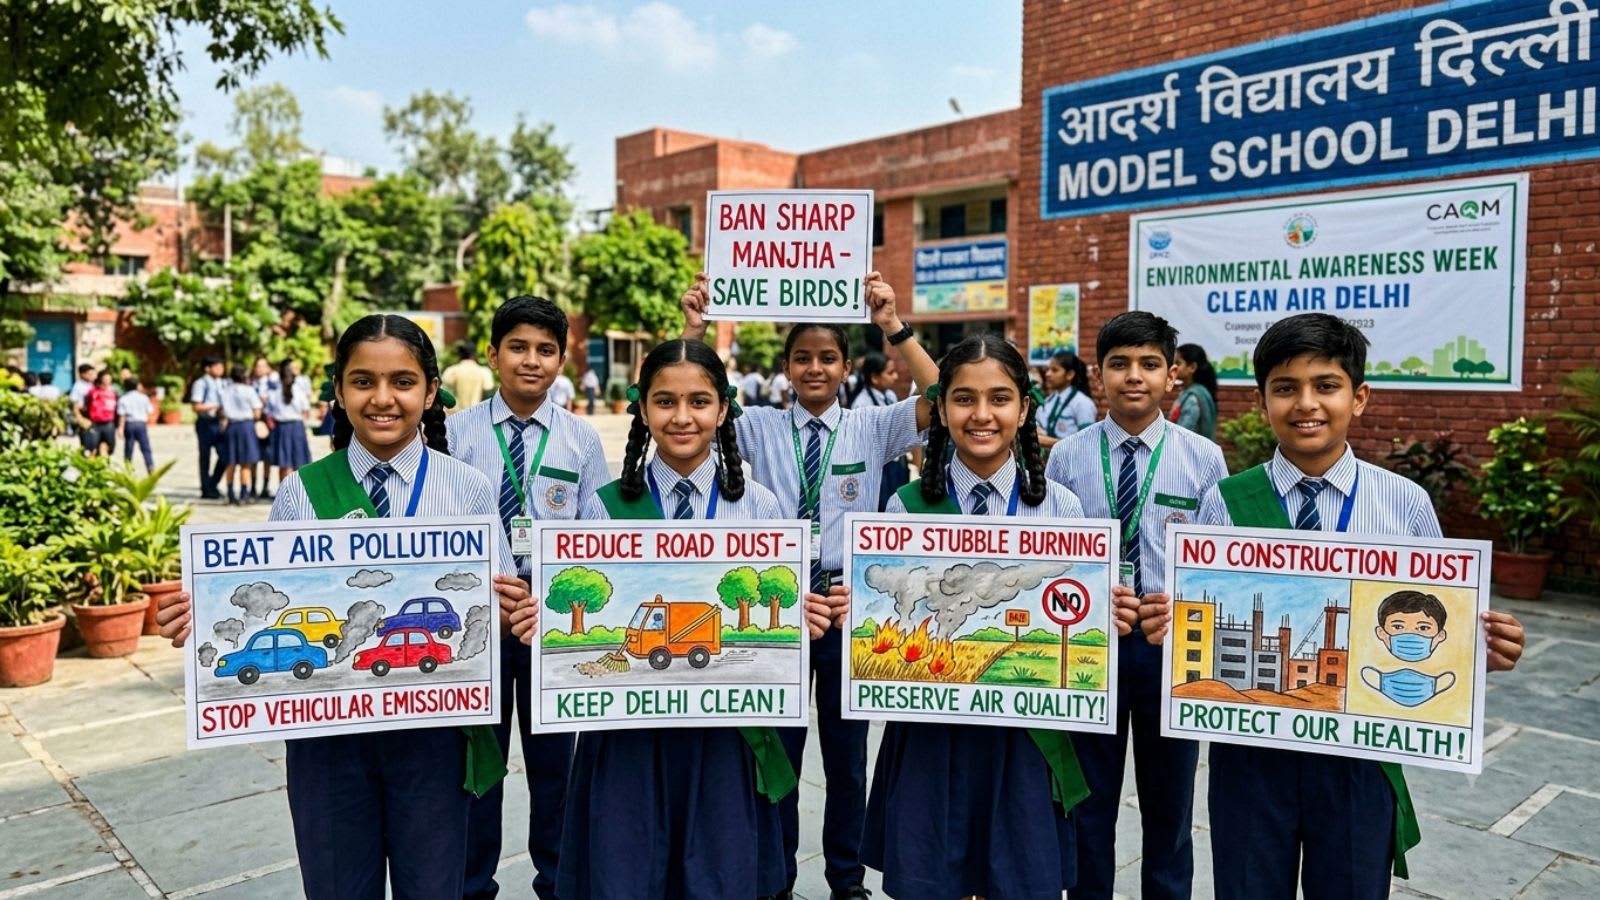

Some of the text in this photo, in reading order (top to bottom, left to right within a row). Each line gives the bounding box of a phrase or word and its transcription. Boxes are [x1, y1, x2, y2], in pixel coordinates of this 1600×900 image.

[1057, 0, 1599, 146] आदर्श विद्यालय दिल्ली
[1058, 86, 1597, 202] MODEL SCHOOL DELHI
[719, 203, 855, 231] BAN SHARP
[1426, 199, 1500, 221] CAQM
[1146, 246, 1498, 287] ENVIRONMENTAL AWARENESS WEEK
[713, 278, 768, 306] SAVE
[1207, 283, 1410, 313] CLEAN AIR DELHI
[204, 530, 483, 568] BEAT AIR POLLUTION
[556, 533, 643, 559] REDUCE
[656, 533, 715, 558] ROAD
[859, 526, 1106, 557] STOP STUBBLE BURNING
[1182, 538, 1474, 581] NO CONSTRUCTION DUST
[1052, 592, 1082, 612] NO
[202, 686, 490, 732] STOP VEHICULAR EMISSIONS!
[557, 691, 614, 718] KEEP
[626, 689, 688, 716] DELHI
[858, 684, 1106, 722] PRESERVE AIR QUALITY!
[1179, 703, 1281, 735] PROTECT
[1292, 714, 1339, 743] OUR
